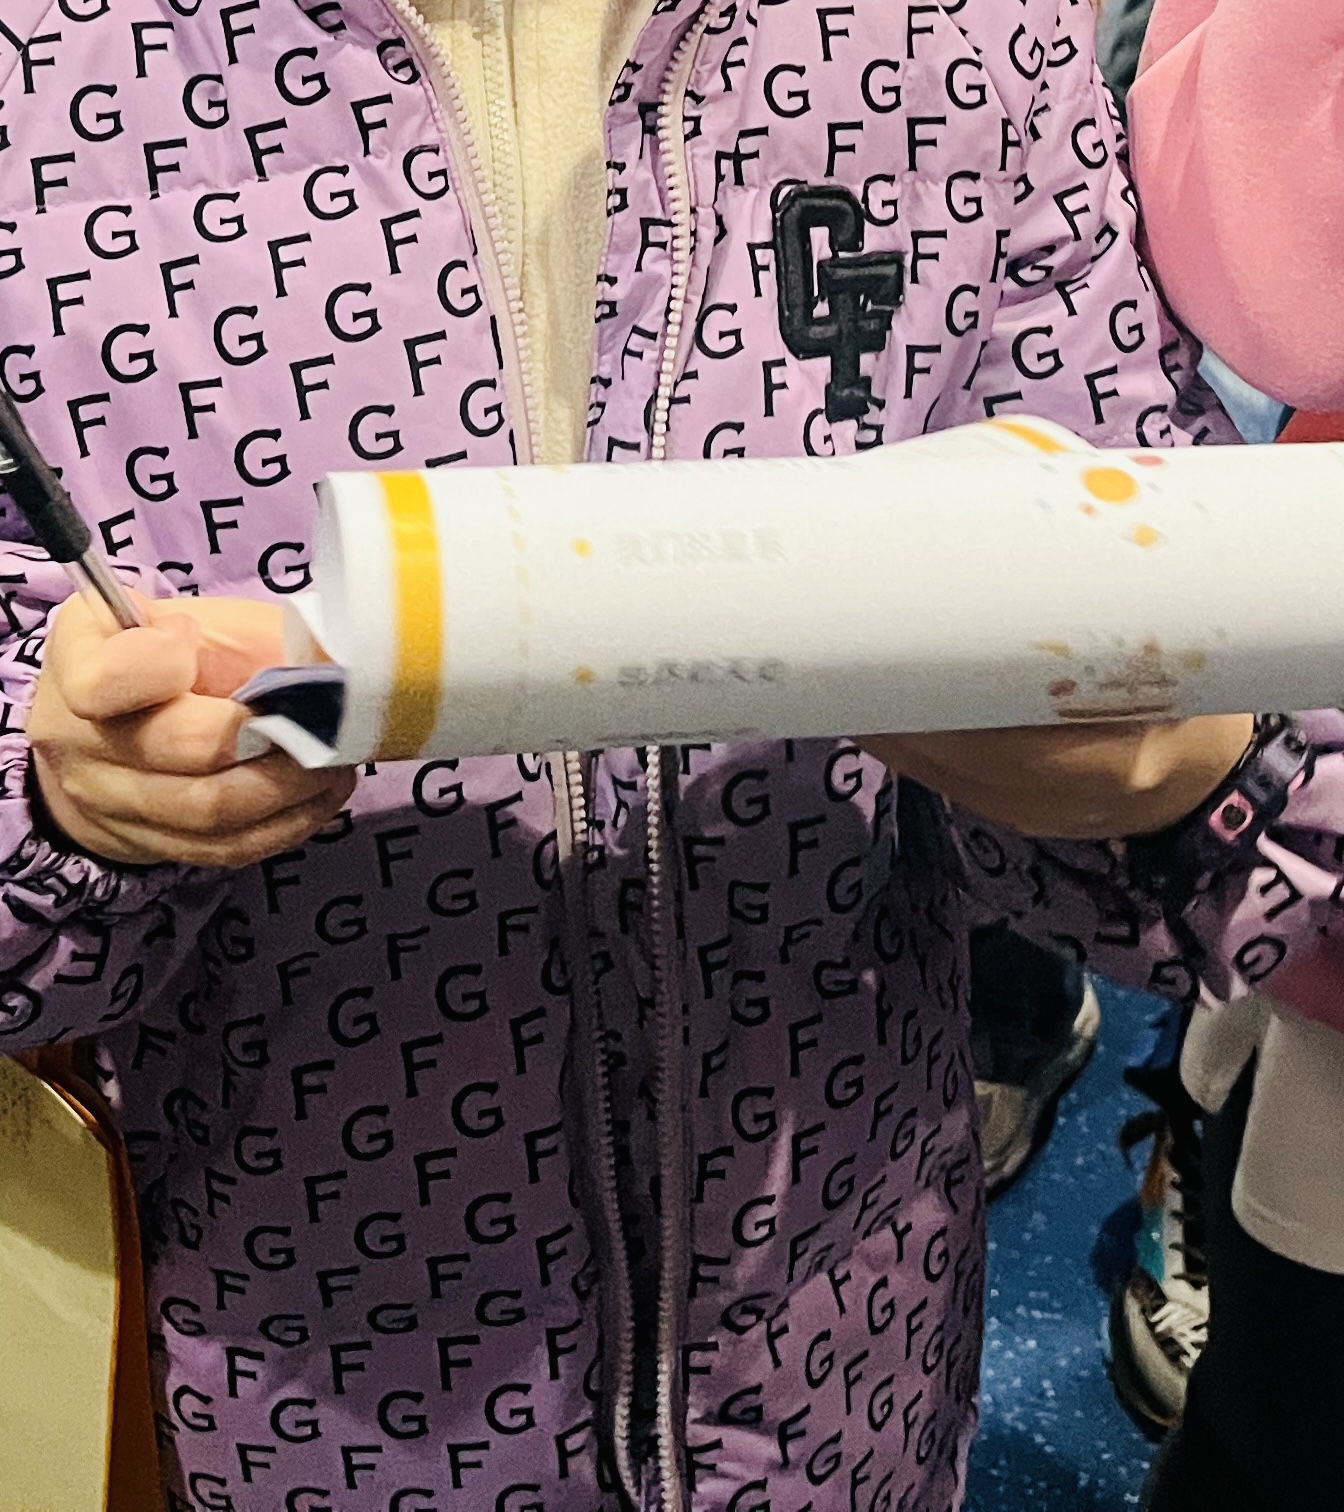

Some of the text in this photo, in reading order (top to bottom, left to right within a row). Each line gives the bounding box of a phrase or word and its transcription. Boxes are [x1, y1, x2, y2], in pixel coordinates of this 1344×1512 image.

[131, 21, 175, 78] F
[816, 5, 854, 62] F
[907, 5, 939, 59] F
[1009, 23, 1045, 81] G
[182, 74, 230, 129] G
[275, 47, 331, 106] G
[764, 64, 811, 118] G
[861, 59, 901, 114] G
[945, 58, 987, 110] G
[69, 84, 124, 142] G
[350, 93, 393, 157] F
[143, 137, 187, 200] F
[243, 118, 287, 182] F
[824, 121, 863, 178] F
[906, 116, 946, 172] F
[1071, 117, 1108, 169] G
[30, 152, 75, 215] F
[303, 165, 359, 220] G
[403, 144, 450, 201] G
[945, 170, 983, 223] G
[84, 205, 139, 260] G
[193, 192, 247, 243] G
[1053, 182, 1090, 242] F
[267, 233, 312, 298] F
[380, 209, 421, 275] F
[910, 229, 947, 284] F
[46, 269, 91, 337] F
[160, 254, 200, 318] F
[325, 282, 382, 342] G
[437, 260, 483, 318] G
[945, 284, 980, 337] G
[101, 323, 158, 384] G
[213, 305, 268, 366] G
[1012, 325, 1064, 380] G
[1109, 300, 1145, 353] G
[289, 353, 335, 421] F
[403, 330, 447, 397] F
[904, 344, 941, 399] F
[178, 377, 222, 440] F
[460, 378, 505, 437] G
[1084, 364, 1119, 425] F
[67, 392, 110, 458] F
[348, 404, 404, 461] G
[126, 446, 179, 502] G
[234, 428, 291, 487] G
[200, 496, 244, 555] F
[258, 542, 313, 594] G
[413, 758, 465, 818] G
[721, 768, 771, 828] G
[484, 790, 523, 859] F
[787, 814, 827, 878] F
[259, 849, 306, 914] F
[374, 825, 420, 888] F
[681, 835, 725, 891] F
[315, 894, 368, 946] G
[427, 869, 479, 917] G
[277, 952, 319, 1006] F
[387, 926, 430, 981] F
[328, 987, 381, 1048] G
[435, 964, 490, 1022] G
[223, 1014, 270, 1069] G
[400, 1032, 444, 1098] F
[509, 1006, 546, 1076] F
[788, 1011, 823, 1078] F
[291, 1059, 335, 1121] F
[451, 1081, 505, 1139] G
[825, 1054, 865, 1110] G
[342, 1104, 394, 1161] G
[731, 1087, 777, 1143] G
[235, 1126, 284, 1176] G
[414, 1147, 457, 1207] F
[523, 1118, 565, 1184] F
[791, 1122, 826, 1186] F
[205, 1167, 237, 1219] F
[303, 1170, 347, 1224] F
[464, 1192, 517, 1245] G
[732, 1195, 776, 1248] G
[244, 1226, 297, 1272] G
[354, 1212, 406, 1259] G
[536, 1224, 573, 1288] F
[209, 1267, 250, 1311] F
[316, 1265, 360, 1310] F
[425, 1252, 471, 1301] F
[367, 1303, 419, 1335] G
[475, 1290, 527, 1327] G
[225, 1347, 265, 1398] F
[329, 1340, 372, 1395] F
[437, 1335, 480, 1392] F
[546, 1318, 583, 1380] F
[174, 1385, 217, 1432] G
[270, 1398, 322, 1444] G
[377, 1390, 429, 1440] G
[484, 1383, 536, 1435] G
[236, 1443, 277, 1483] F
[341, 1445, 383, 1490] F
[447, 1441, 490, 1489] F
